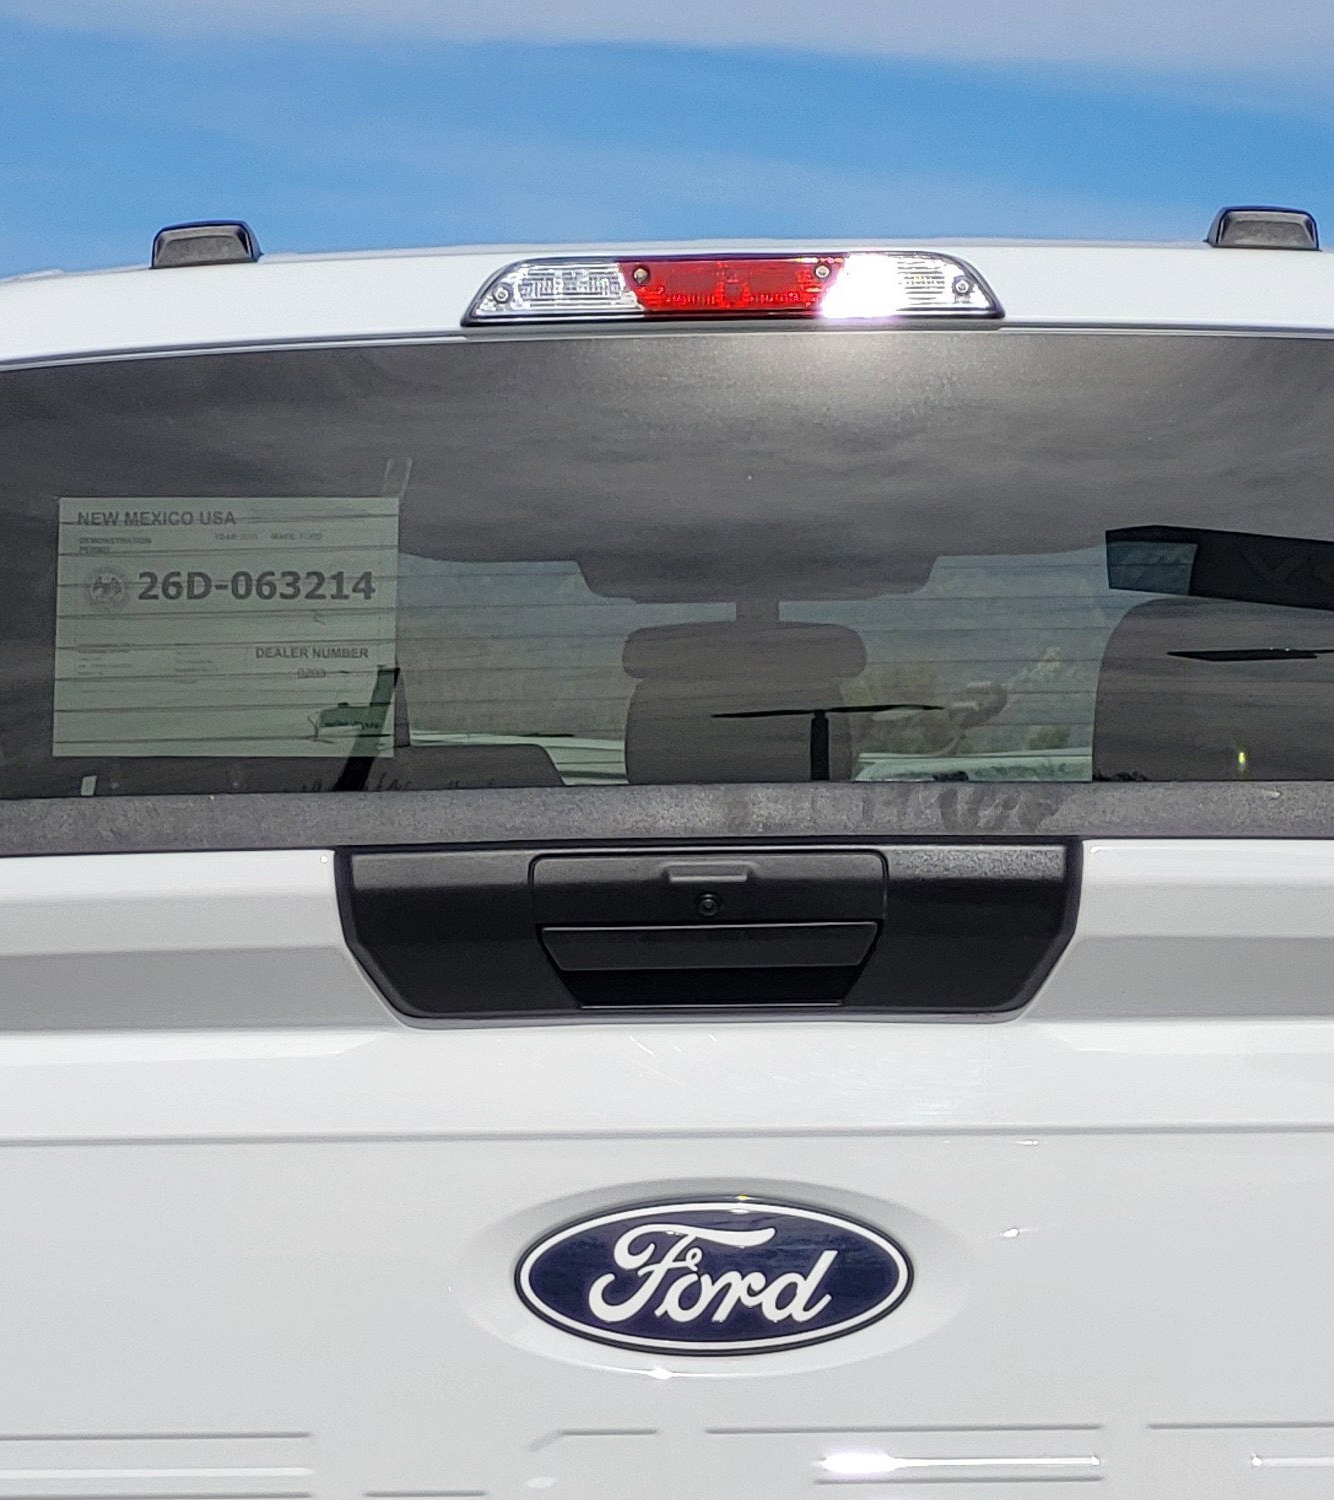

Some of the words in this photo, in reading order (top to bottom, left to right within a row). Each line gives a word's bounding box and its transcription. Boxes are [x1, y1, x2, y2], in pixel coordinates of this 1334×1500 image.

[77, 511, 119, 526] NEW
[124, 511, 193, 526] MEXICO
[199, 510, 236, 525] USA
[138, 571, 376, 600] 26D-063214
[255, 646, 308, 659] DEALER
[312, 646, 369, 659] NUMBER
[588, 1223, 839, 1323] Ford
